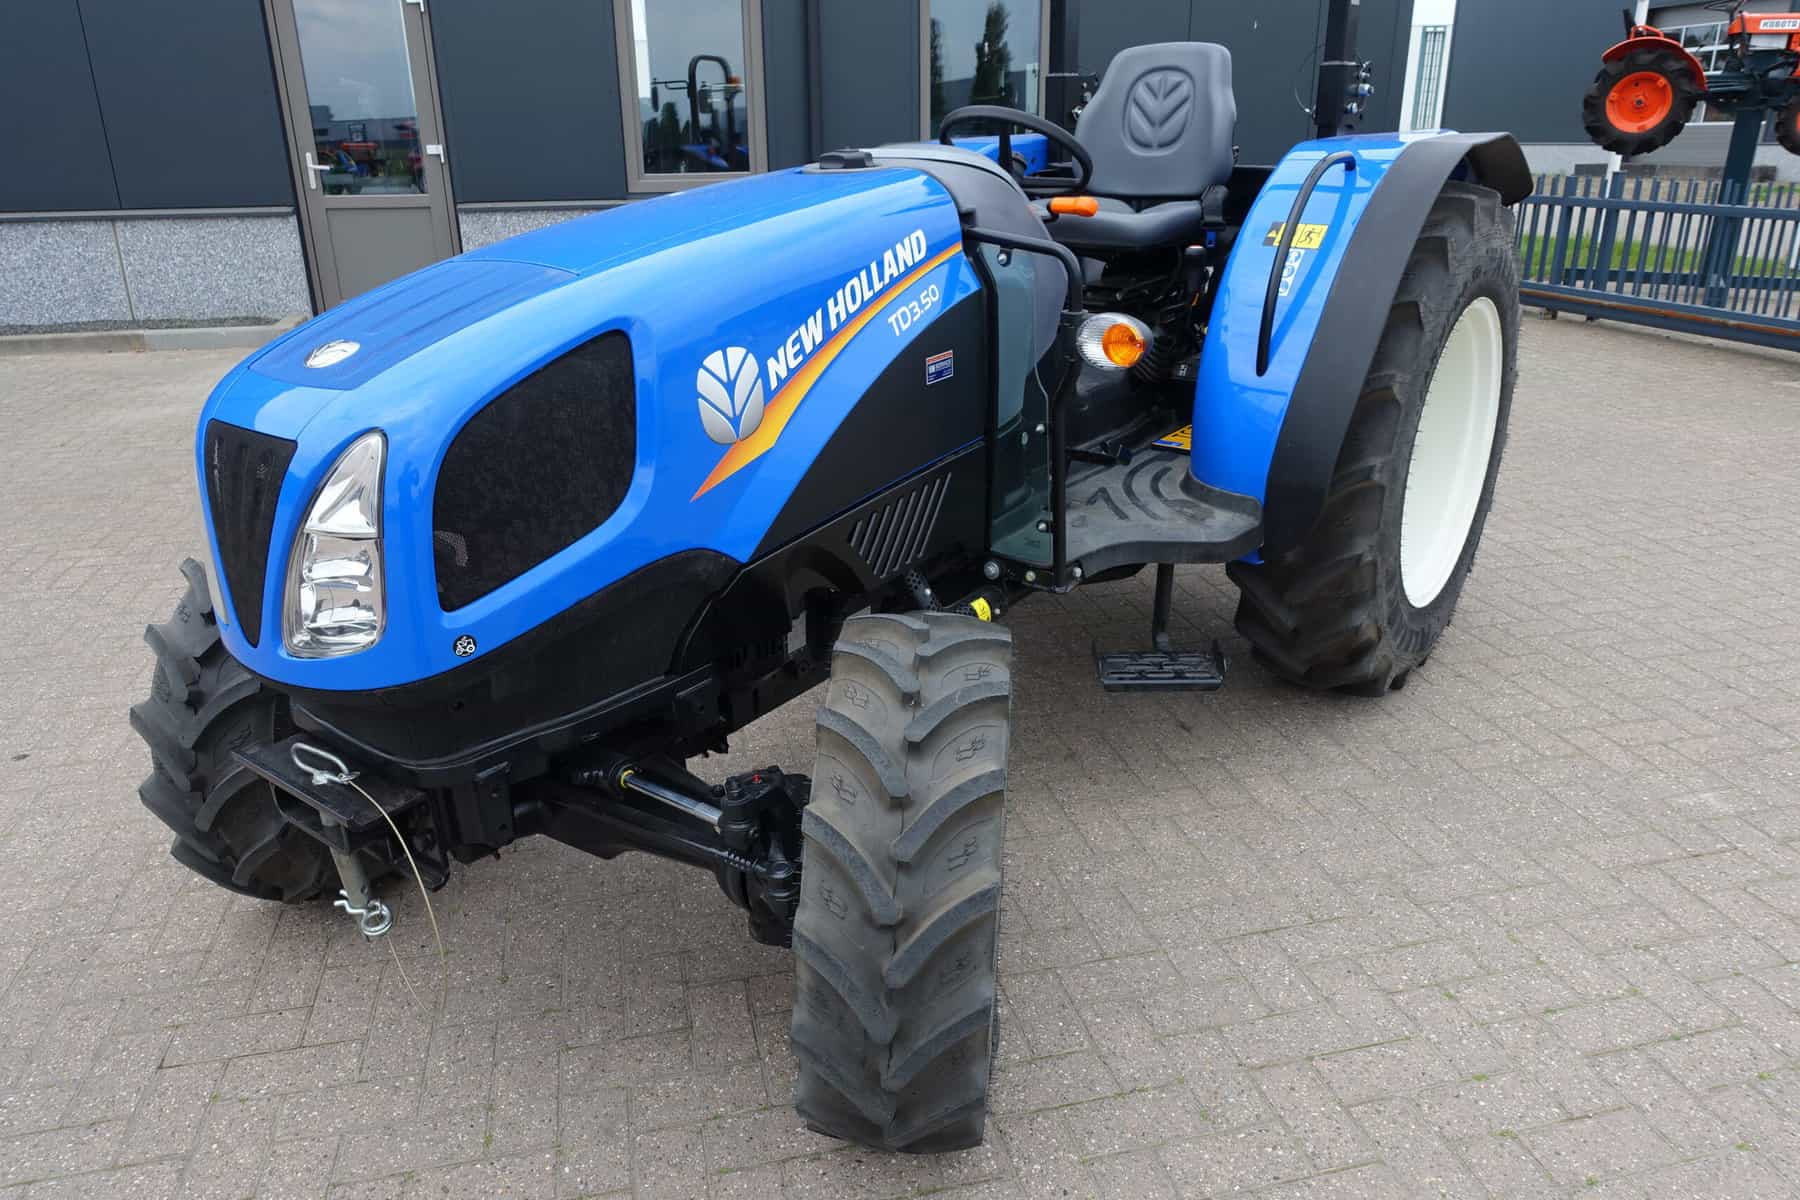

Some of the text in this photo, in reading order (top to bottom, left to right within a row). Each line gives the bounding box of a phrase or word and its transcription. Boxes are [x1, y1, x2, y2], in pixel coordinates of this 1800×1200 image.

[767, 229, 927, 391] NEW HOLLAND
[888, 284, 940, 337] TD3.50
